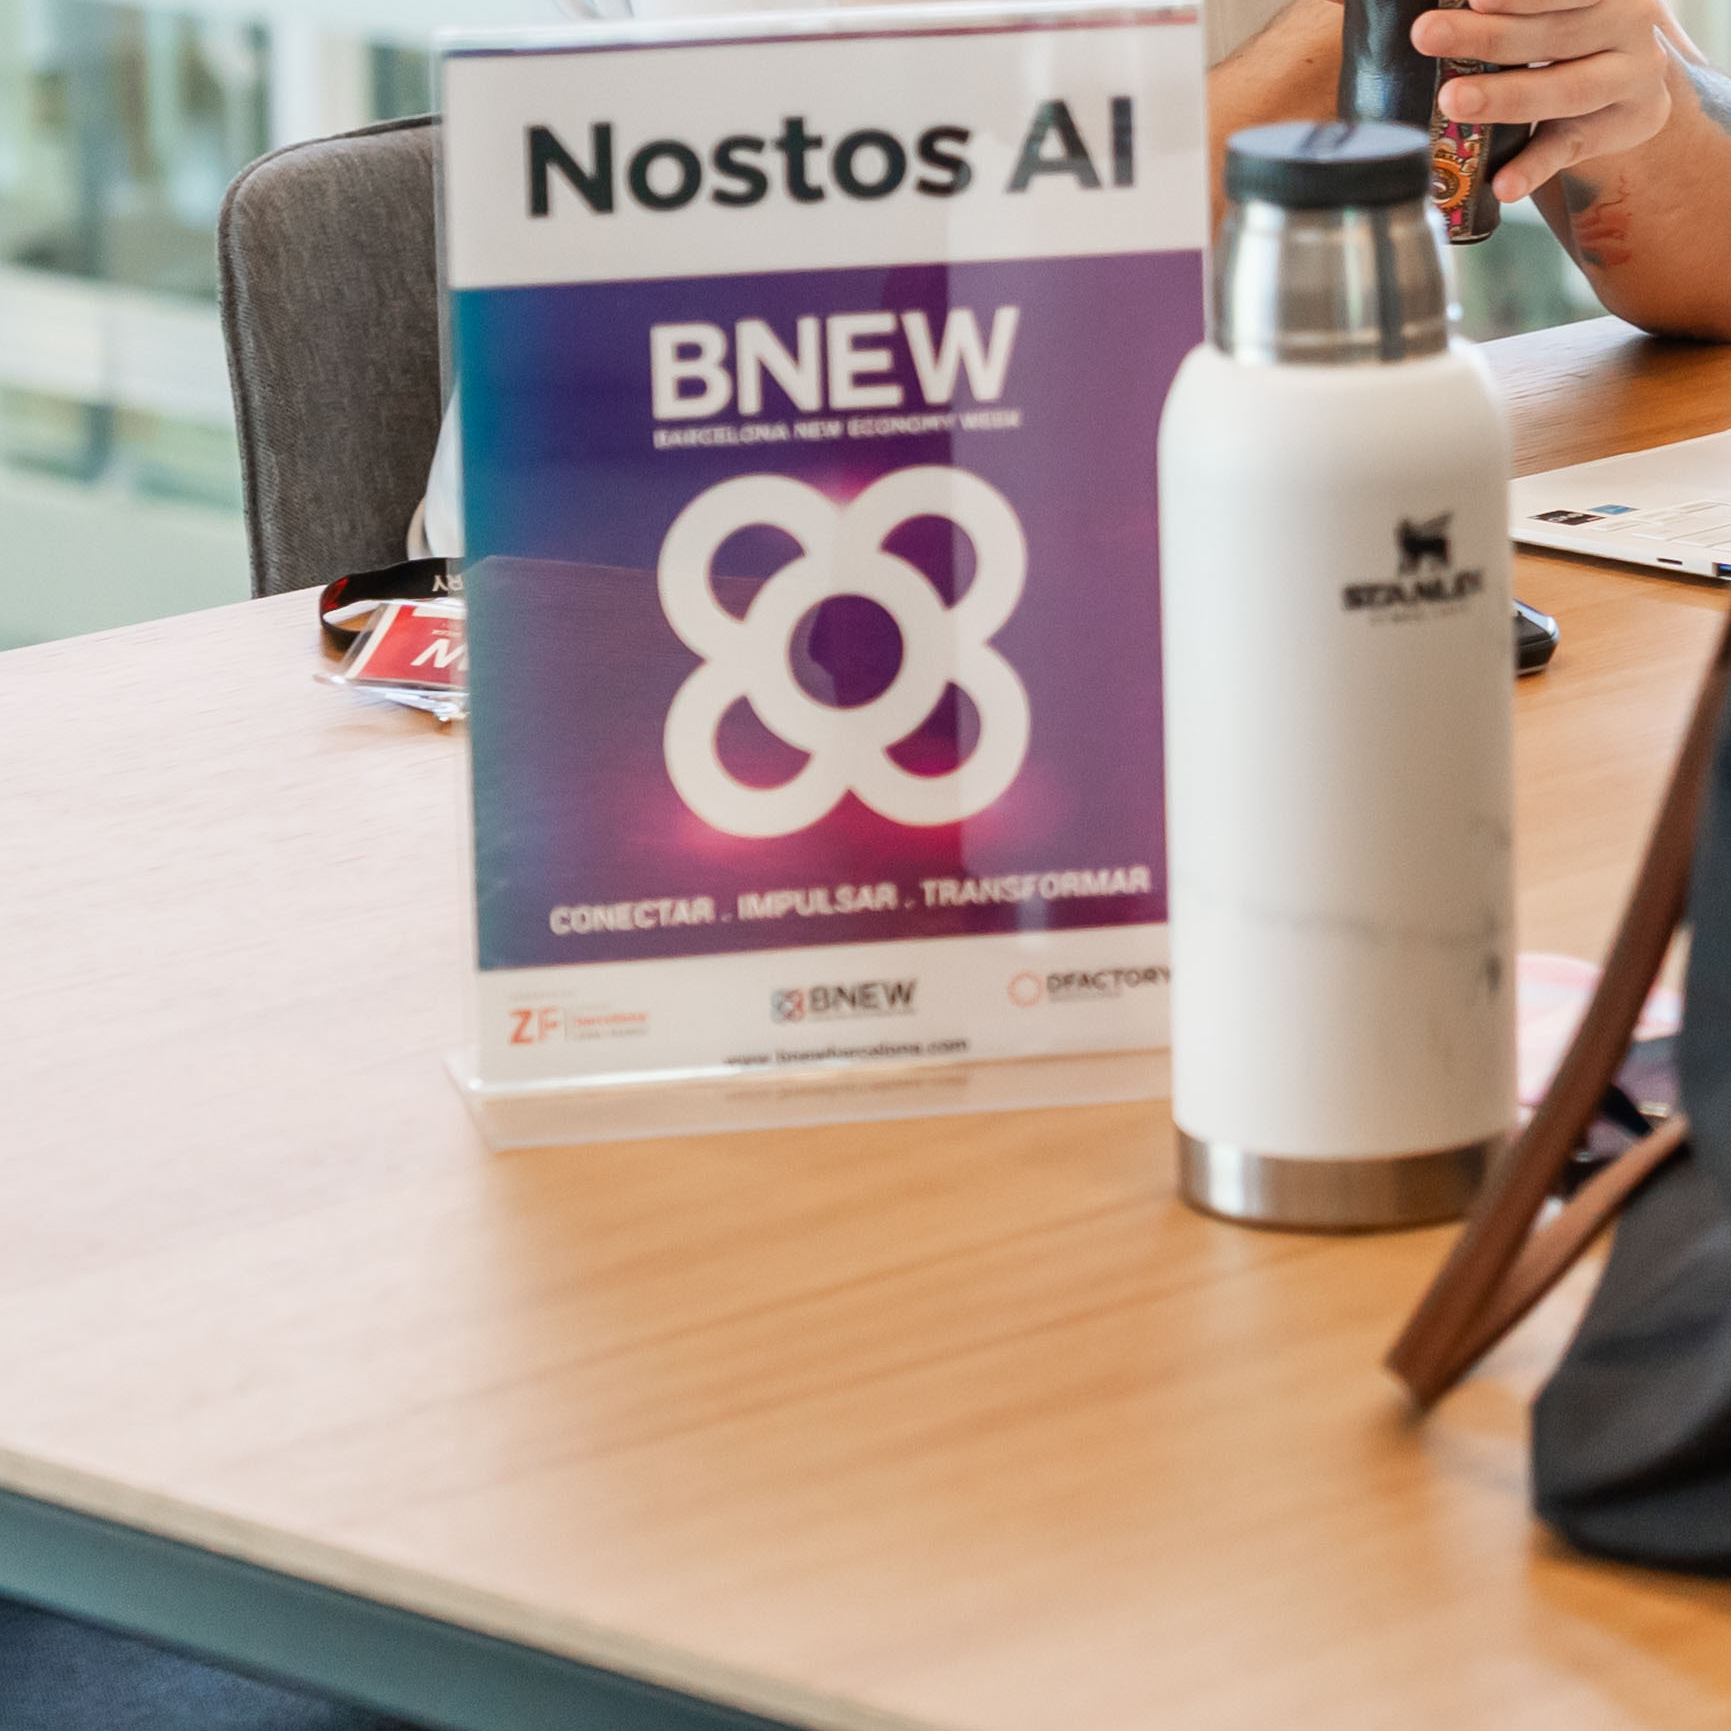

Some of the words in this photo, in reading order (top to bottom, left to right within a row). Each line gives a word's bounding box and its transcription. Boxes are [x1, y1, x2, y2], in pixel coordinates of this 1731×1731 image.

[525, 115, 973, 219] Nostos
[1007, 94, 1137, 194] AI
[649, 304, 1021, 421] BNEW
[794, 419, 842, 440] NEW
[549, 895, 716, 936] CONECTAR
[737, 882, 898, 921] IMPULSAR
[919, 865, 1151, 907] TRANSFORMAR
[810, 978, 918, 1013] BNEW
